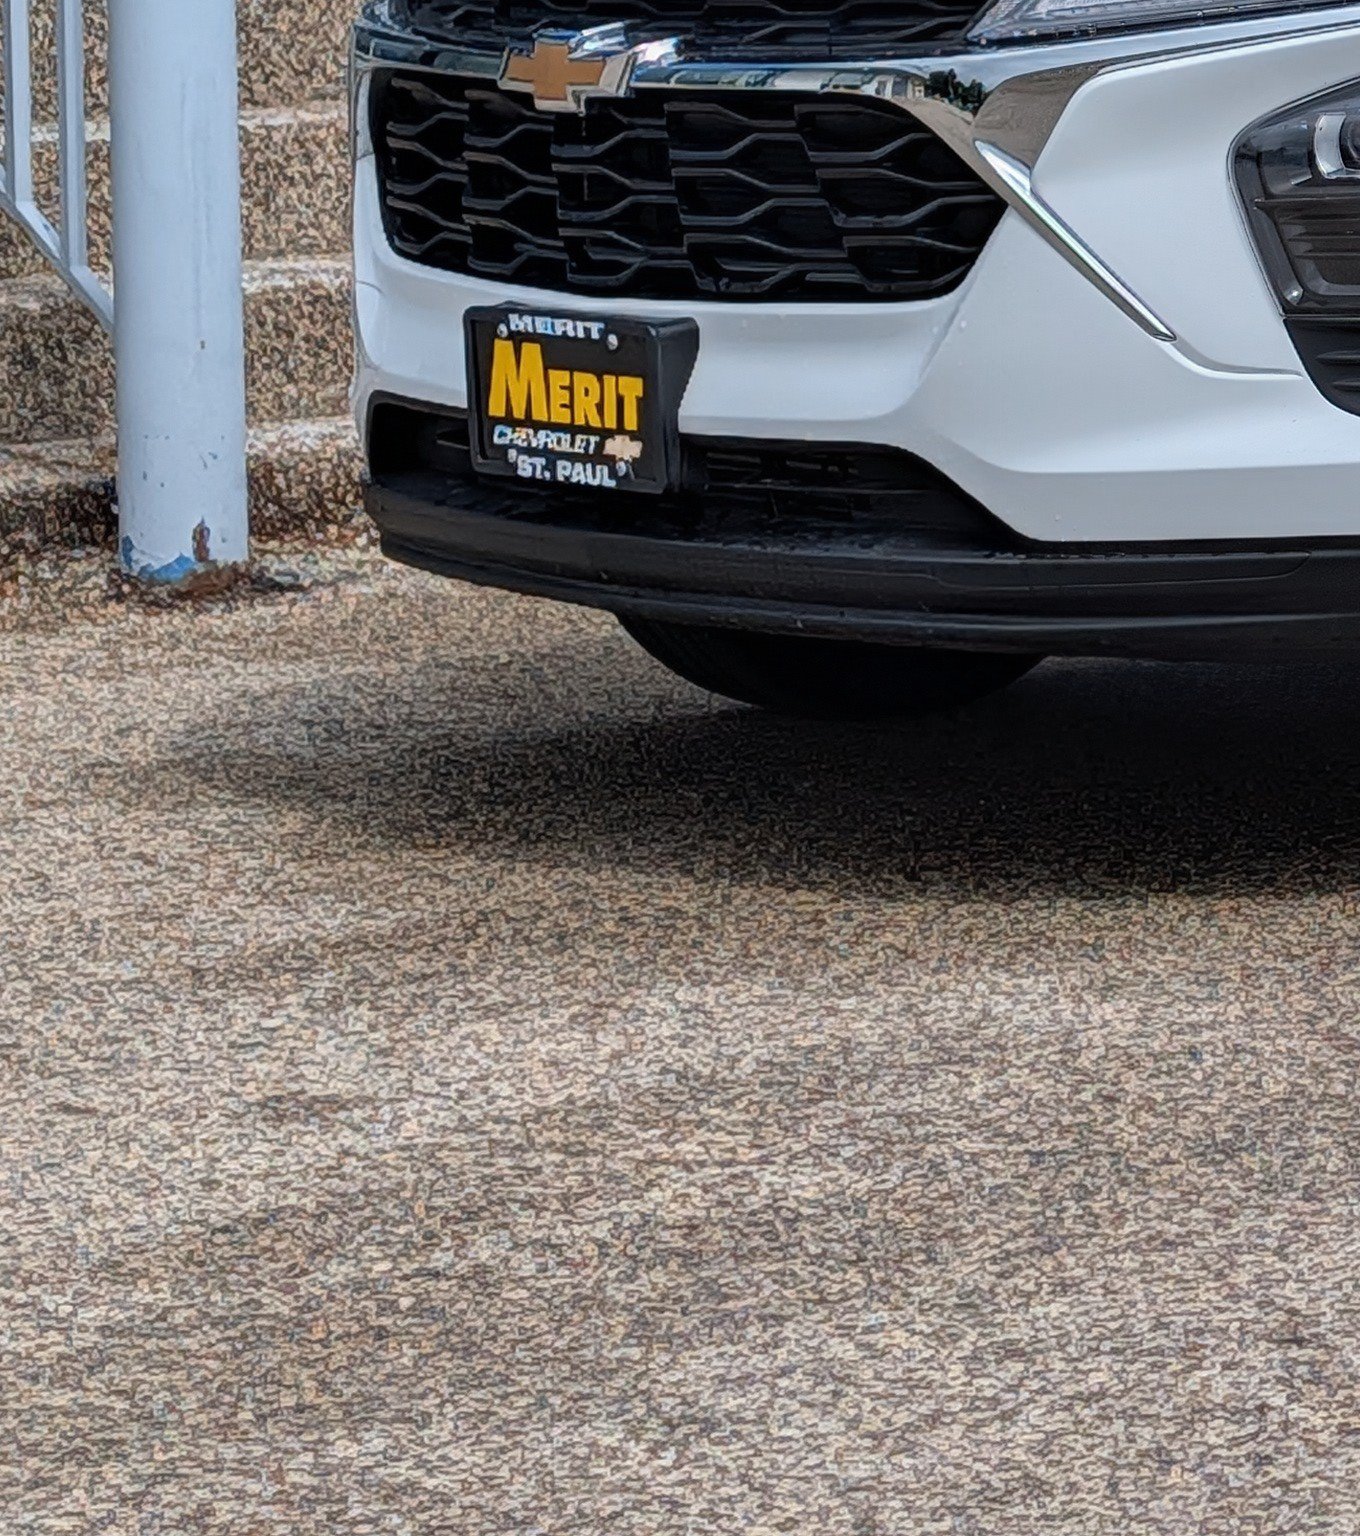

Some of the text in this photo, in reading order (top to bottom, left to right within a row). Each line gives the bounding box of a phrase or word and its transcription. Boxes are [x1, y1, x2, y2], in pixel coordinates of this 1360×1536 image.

[507, 313, 605, 340] MERIT
[487, 337, 644, 431] MERIT
[493, 424, 600, 455] CHEVROLET
[516, 454, 617, 488] ST. PAUL
